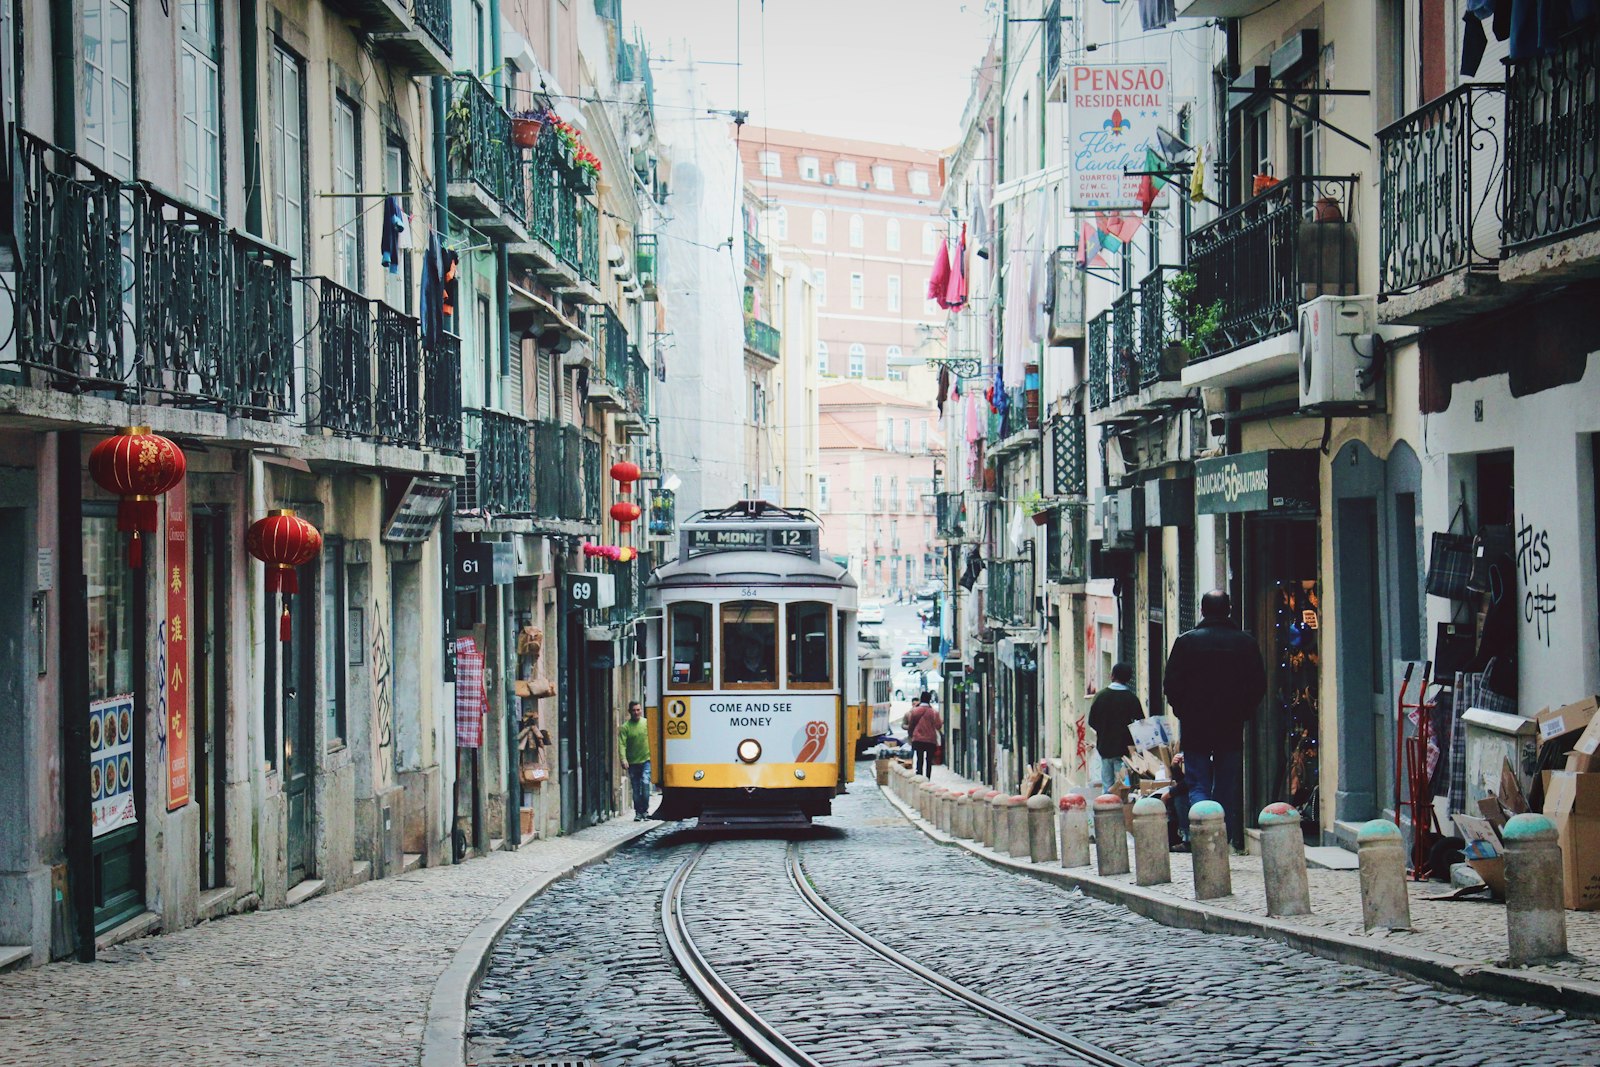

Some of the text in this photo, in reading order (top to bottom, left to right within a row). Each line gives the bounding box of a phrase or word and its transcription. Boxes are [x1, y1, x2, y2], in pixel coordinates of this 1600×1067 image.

[1075, 94, 1162, 108] RESIDENCIAL
[1080, 131, 1126, 153] Flor
[1225, 463, 1238, 503] 56
[718, 531, 765, 544] MONIZ
[780, 530, 801, 545] 12
[462, 559, 479, 573] 61
[572, 582, 591, 600] 69
[741, 588, 757, 597] 564
[709, 703, 792, 713] COME AND SEE
[730, 717, 772, 727] MONEY
